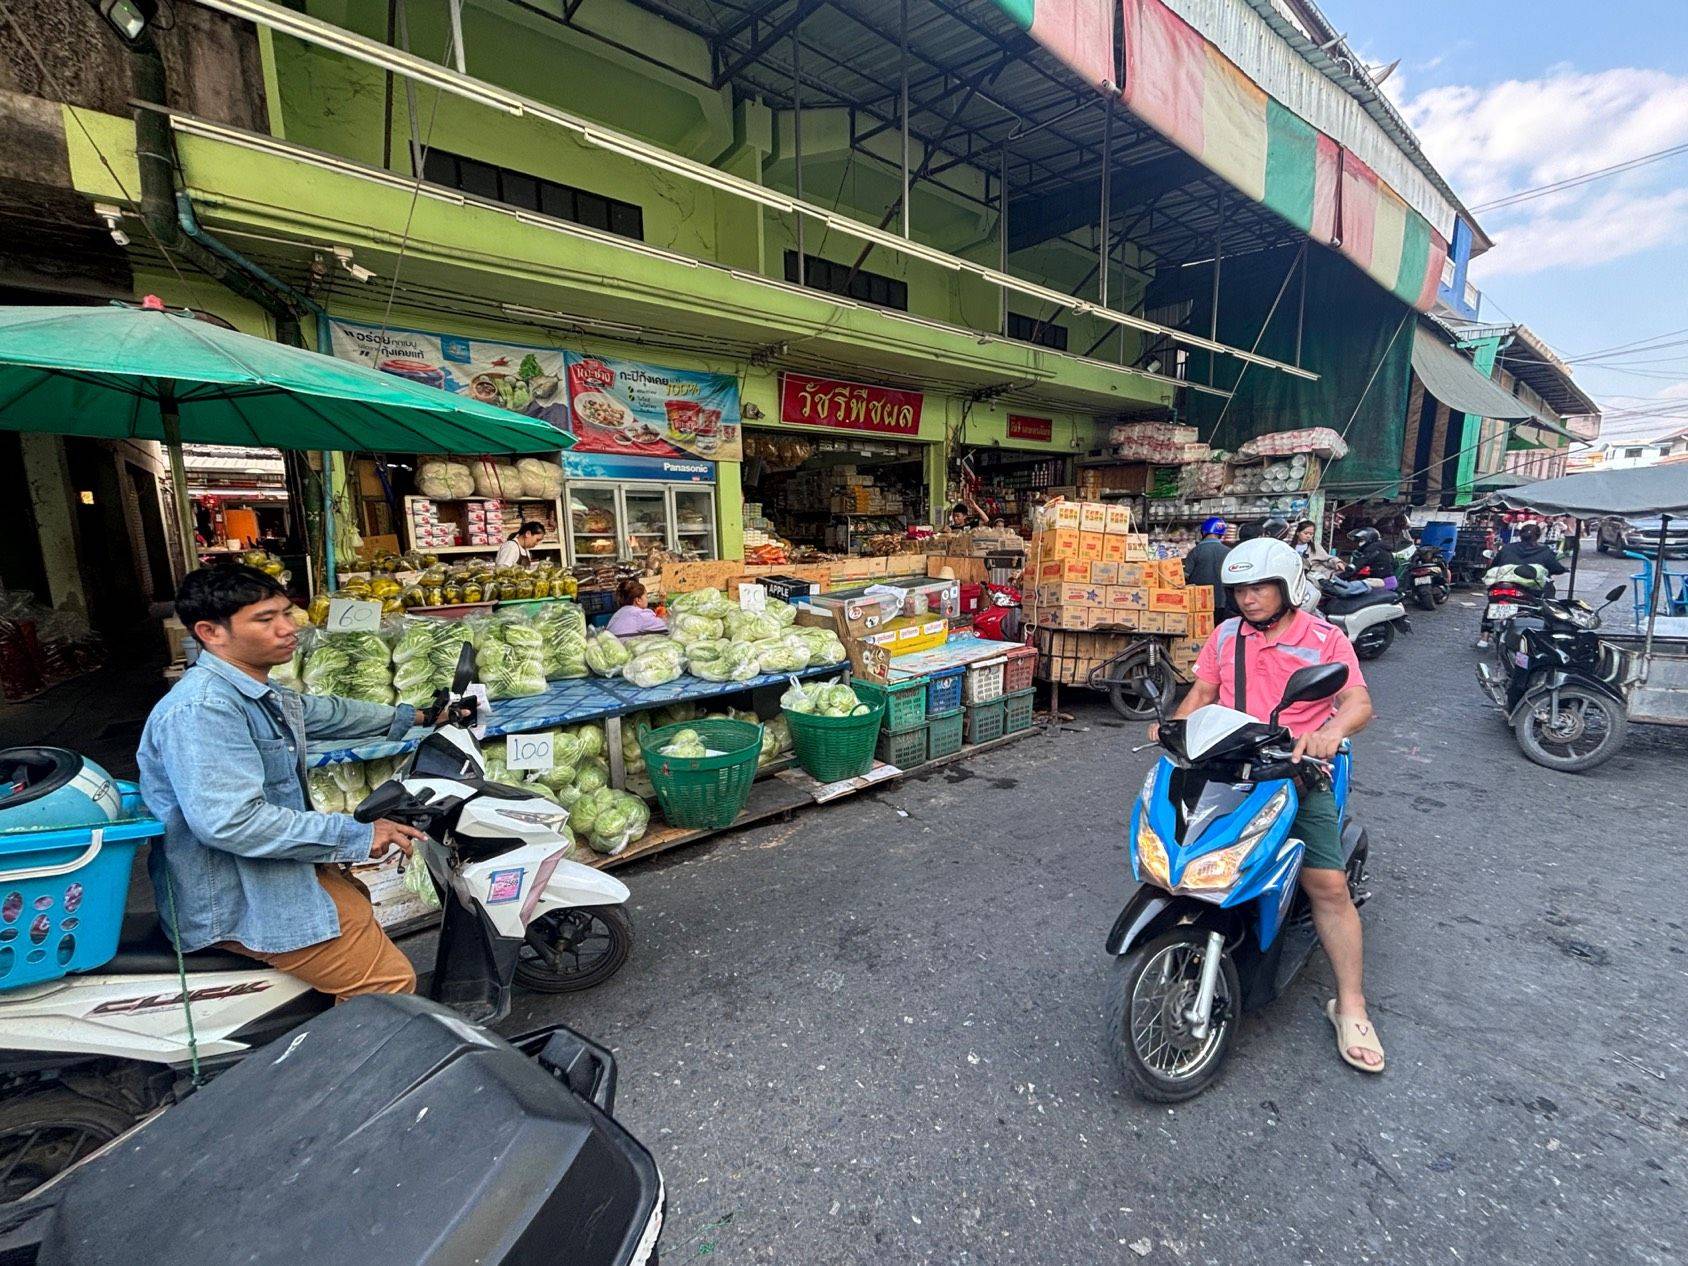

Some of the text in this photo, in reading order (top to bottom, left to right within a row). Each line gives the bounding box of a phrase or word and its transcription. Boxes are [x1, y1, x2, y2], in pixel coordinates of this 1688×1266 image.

[667, 383, 699, 396] 100%
[798, 382, 914, 429] วัชรีพืชผล
[663, 462, 709, 473] Panasonic
[768, 584, 790, 598] APPLE
[339, 604, 373, 627] 60
[513, 738, 550, 762] 100
